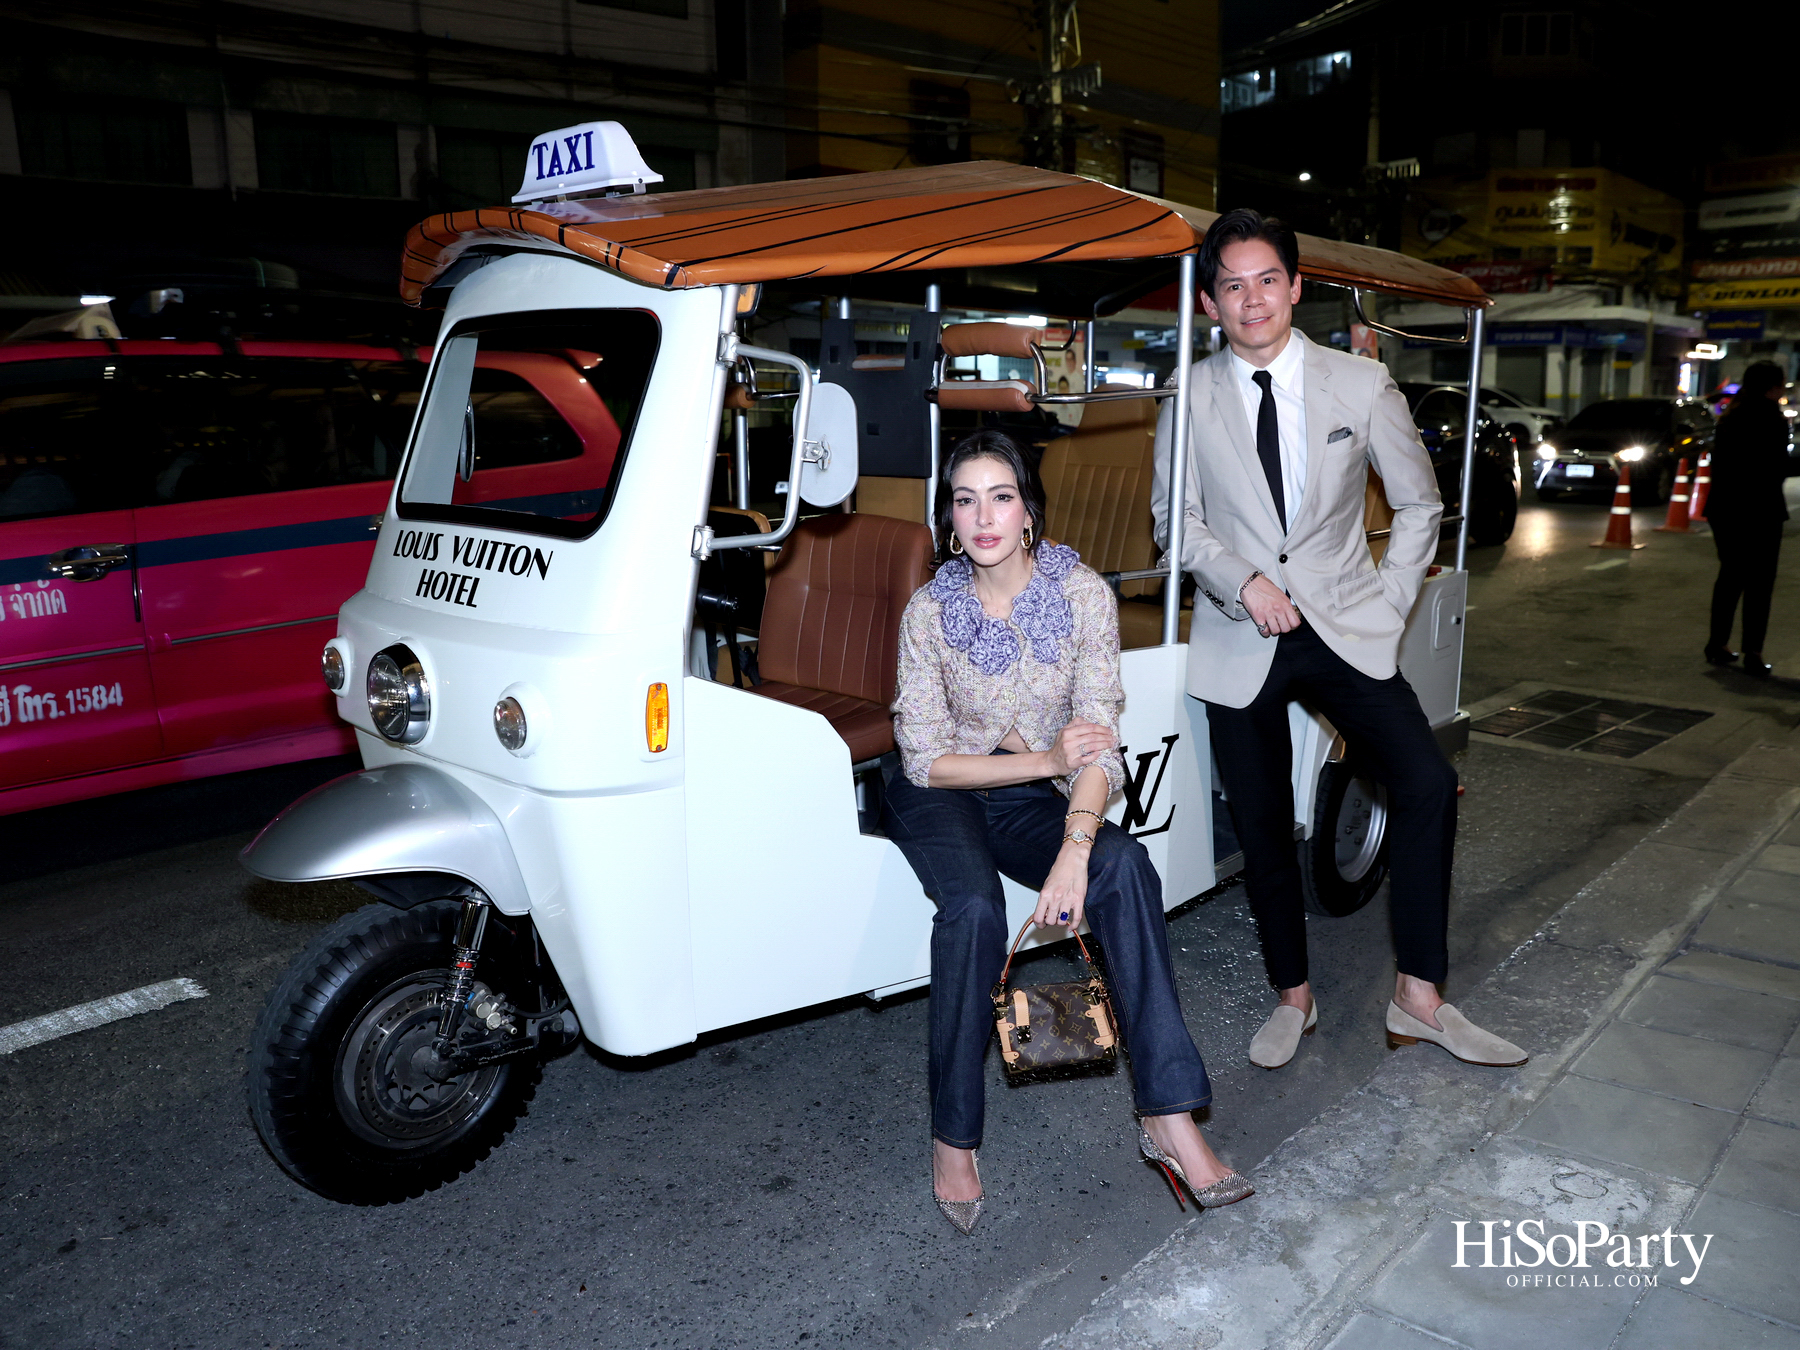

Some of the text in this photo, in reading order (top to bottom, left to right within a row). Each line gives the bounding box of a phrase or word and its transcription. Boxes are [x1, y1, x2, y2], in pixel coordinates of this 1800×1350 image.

[532, 131, 596, 181] TAXI
[393, 529, 554, 581] LOUIS VUITTON
[416, 568, 481, 608] HOTEL
